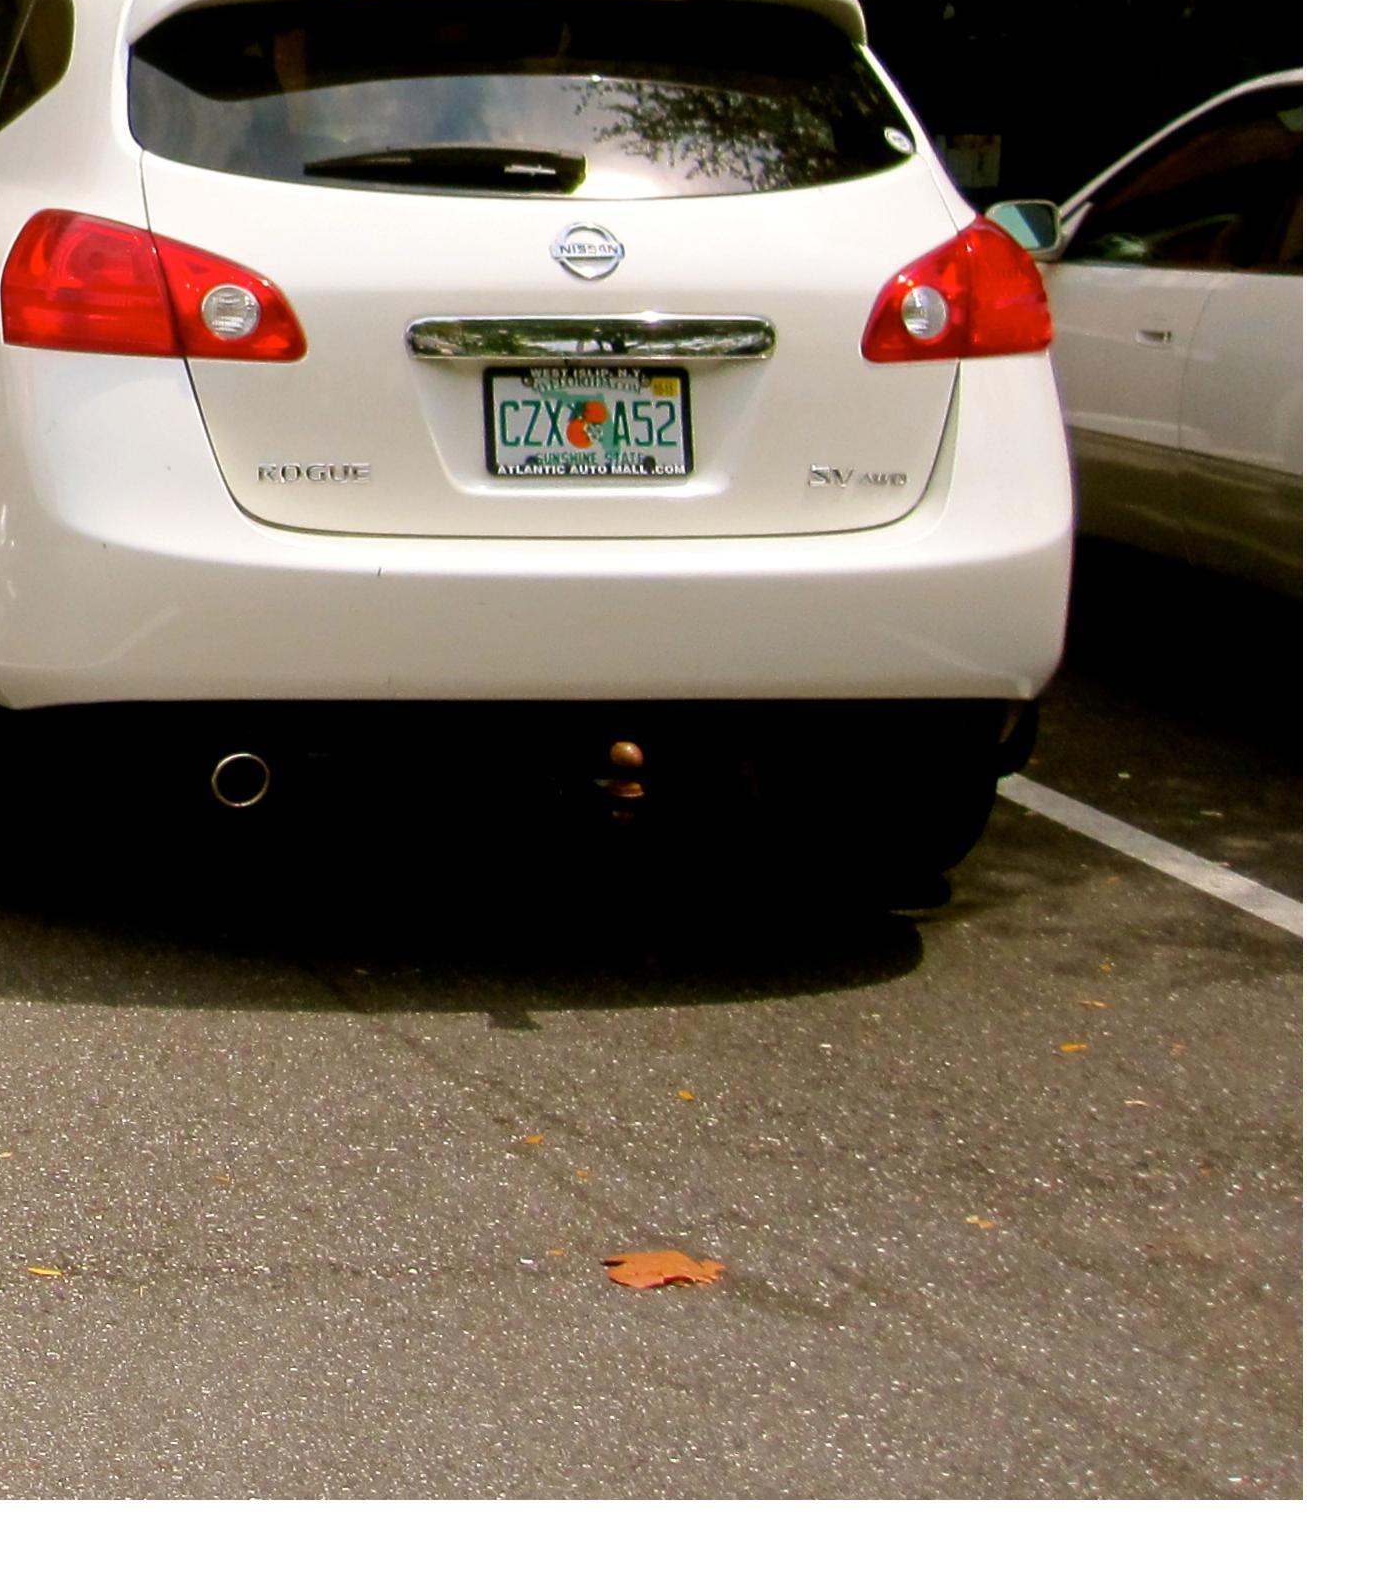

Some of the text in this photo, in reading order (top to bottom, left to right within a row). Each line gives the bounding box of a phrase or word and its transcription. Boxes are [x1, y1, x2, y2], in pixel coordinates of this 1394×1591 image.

[559, 243, 619, 254] NISSAN
[499, 400, 678, 448] CZX A52
[256, 463, 371, 483] ROGUE
[497, 464, 566, 475] ATLANTIC
[569, 464, 608, 475] AUTO
[612, 464, 648, 475] MALL
